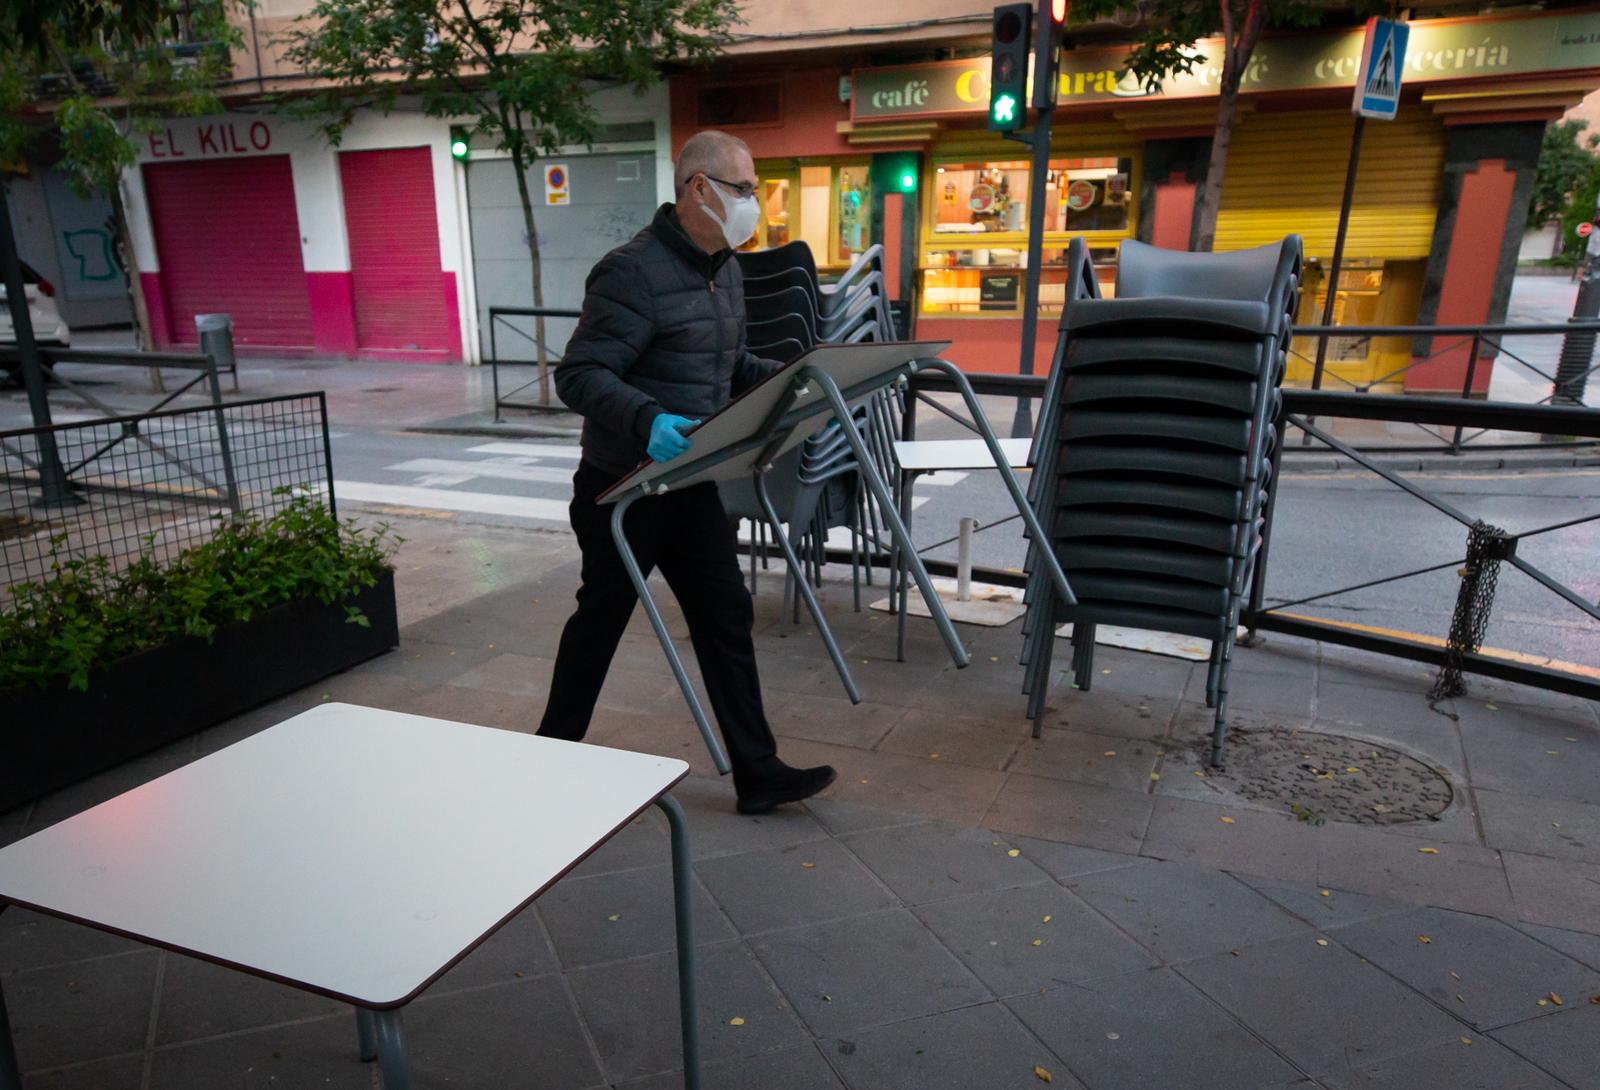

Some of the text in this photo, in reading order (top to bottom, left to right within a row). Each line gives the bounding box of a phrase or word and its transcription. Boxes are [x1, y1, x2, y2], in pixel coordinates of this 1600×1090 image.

[871, 80, 929, 108] café
[149, 120, 271, 157] EL KILO
